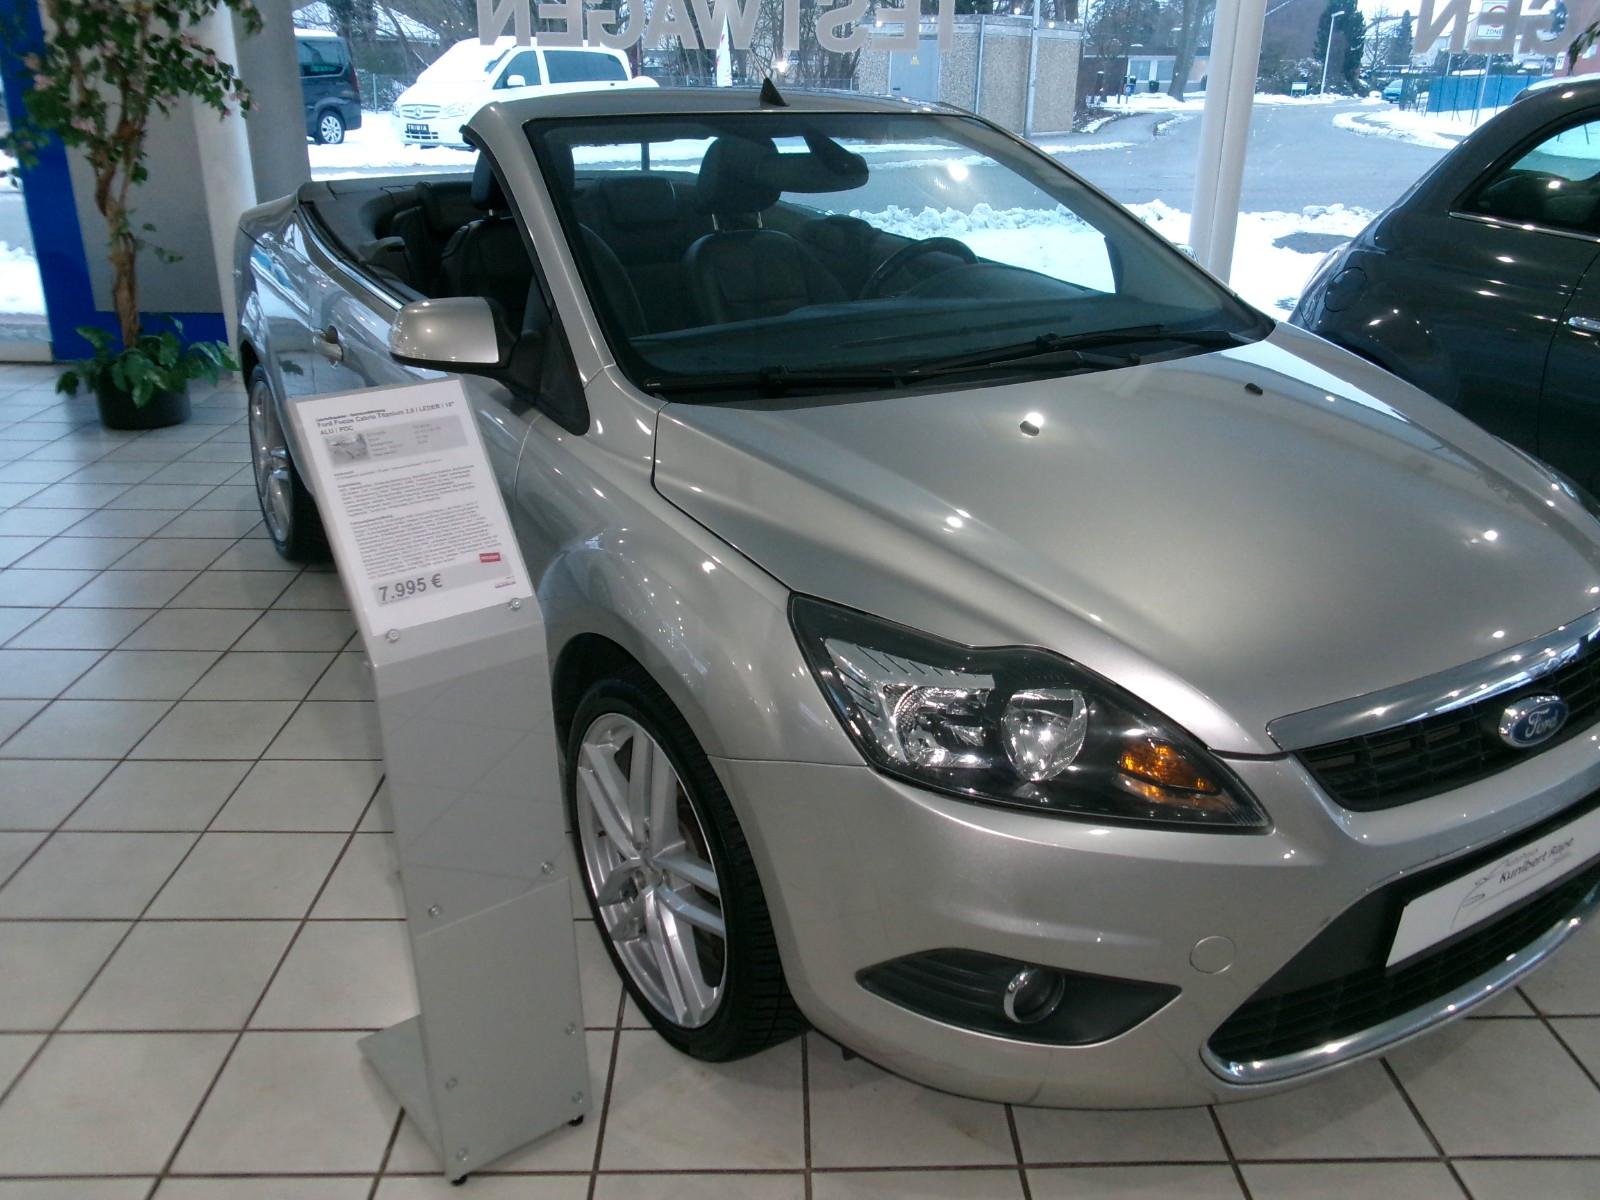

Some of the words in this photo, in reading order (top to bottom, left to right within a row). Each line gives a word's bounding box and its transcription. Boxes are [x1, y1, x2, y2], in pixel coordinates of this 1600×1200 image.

[378, 577, 427, 601] 7.995
[431, 573, 443, 588] €
[1525, 708, 1559, 738] Ford
